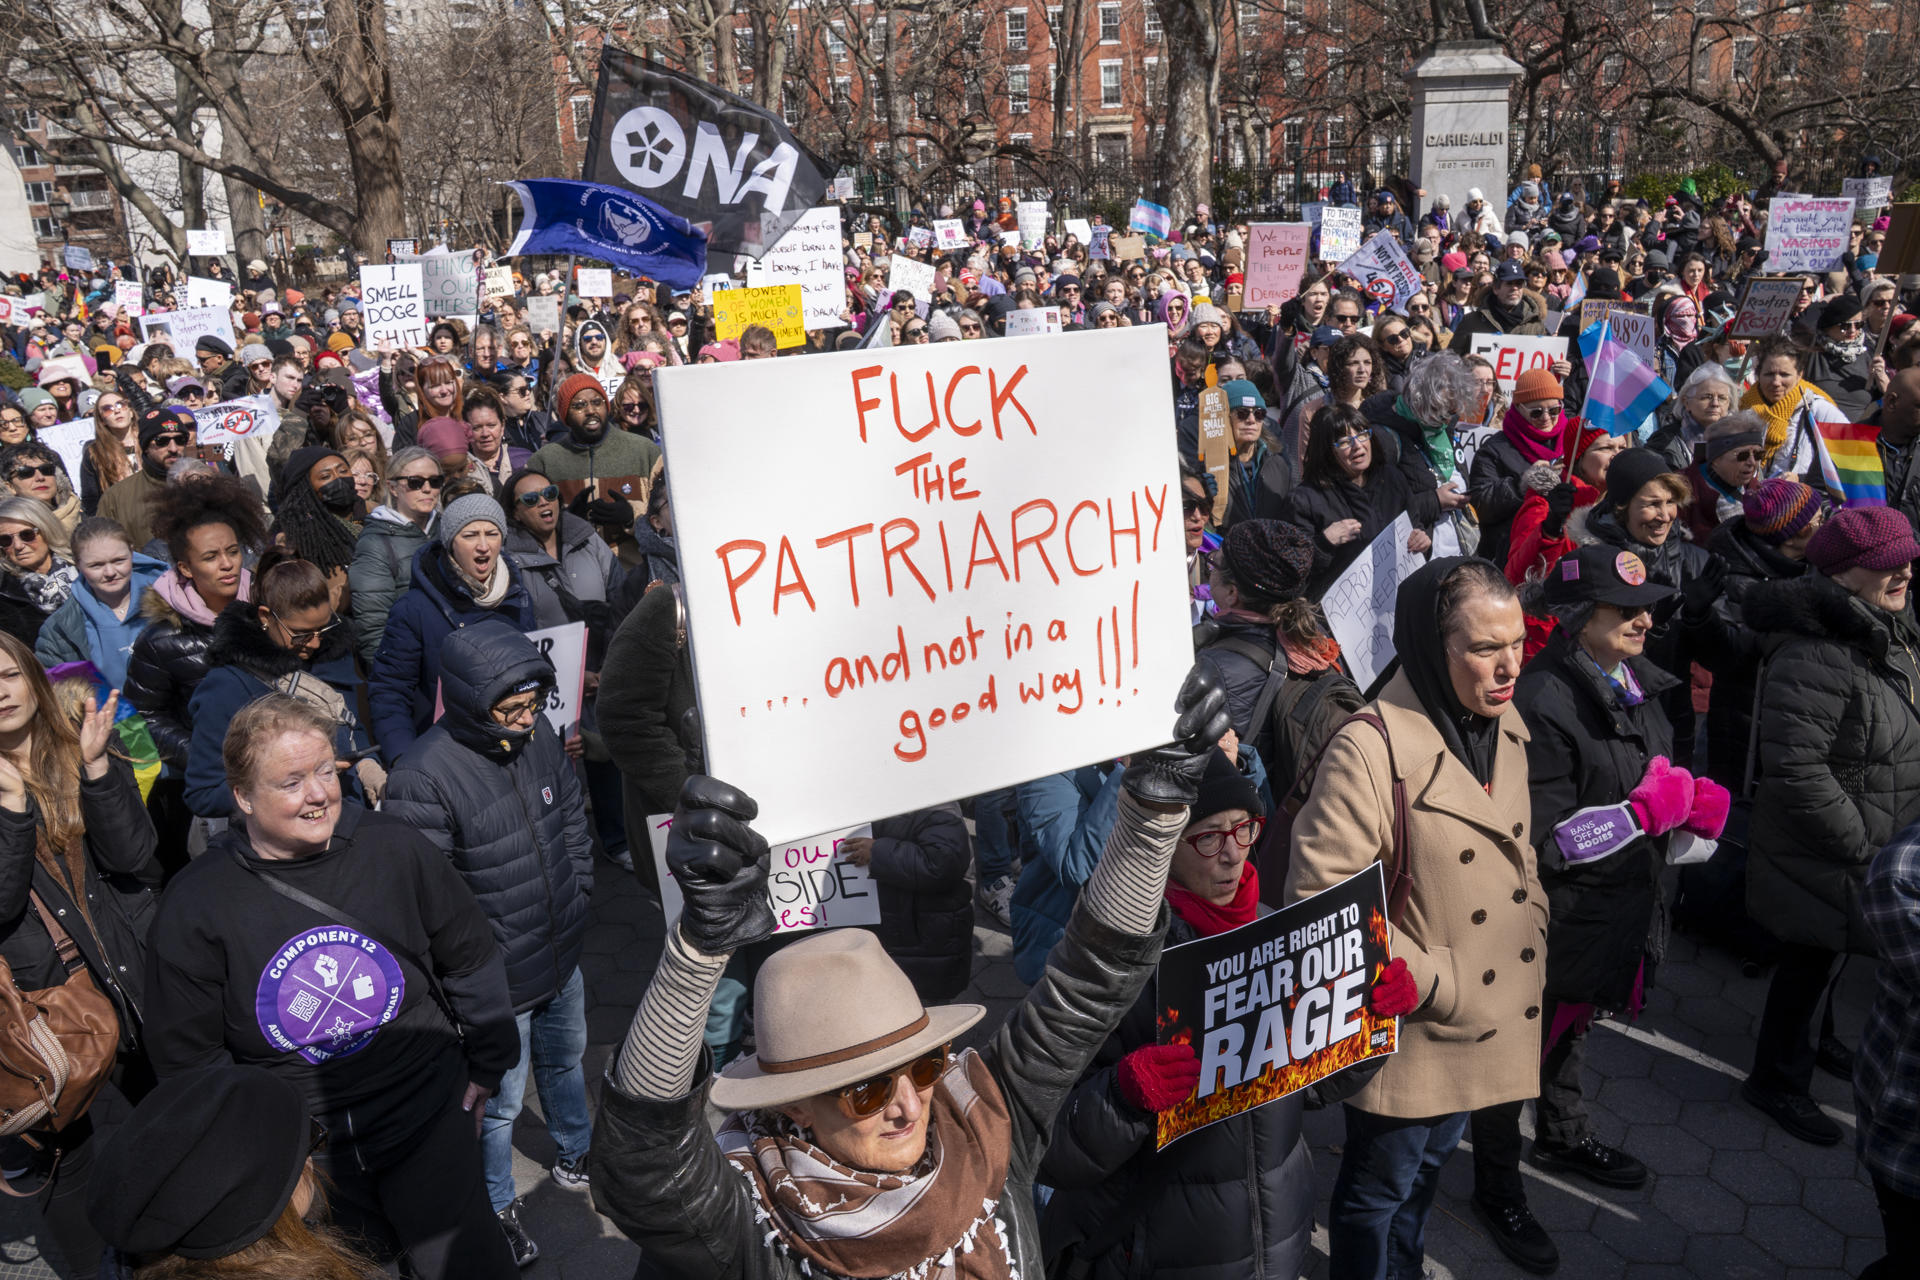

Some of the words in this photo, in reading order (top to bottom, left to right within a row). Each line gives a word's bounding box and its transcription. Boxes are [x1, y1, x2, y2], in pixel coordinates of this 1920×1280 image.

[1426, 131, 1503, 148] GARIBALDI
[1326, 209, 1336, 217] TO
[1338, 209, 1360, 220] THOSE
[1784, 200, 1850, 213] VAGINAS
[1782, 238, 1840, 248] VAGINAS
[1373, 244, 1392, 264] NOT
[1803, 249, 1832, 257] VOTE
[390, 266, 397, 282] I
[1278, 263, 1300, 271] LAST
[364, 284, 418, 306] SMELL
[718, 289, 737, 301] THE
[743, 285, 787, 299] POWER
[729, 300, 746, 312] OF
[747, 295, 791, 310] WOMEN
[734, 312, 747, 323] IS
[750, 308, 779, 321] MUCH
[372, 327, 422, 346] SHIT
[851, 364, 1038, 444] FUCK
[1205, 391, 1220, 405] BIG
[1203, 418, 1226, 432] SMALL
[1206, 429, 1224, 440] PEOPLE
[894, 451, 981, 505] THE
[715, 483, 1168, 627] PATRIARCHY
[1355, 551, 1418, 629] FREEDOM
[923, 615, 986, 675] not
[1004, 611, 1034, 660] in
[1046, 618, 1067, 642] a
[1354, 623, 1391, 674] FOR
[893, 674, 999, 763] good
[1569, 819, 1597, 837] BANS
[1573, 831, 1593, 843] OFF
[1593, 821, 1616, 836] OUR
[1576, 831, 1614, 851] BODIES
[1205, 951, 1245, 984] YOU
[1249, 935, 1286, 970] ARE
[1289, 914, 1339, 954] RIGHT
[1339, 902, 1360, 929] TO
[269, 930, 359, 979] COMPONENT
[360, 938, 377, 954] 12
[1204, 958, 1295, 1030] FEAR
[1301, 928, 1365, 989] OUR
[1197, 968, 1366, 1099] RAGE
